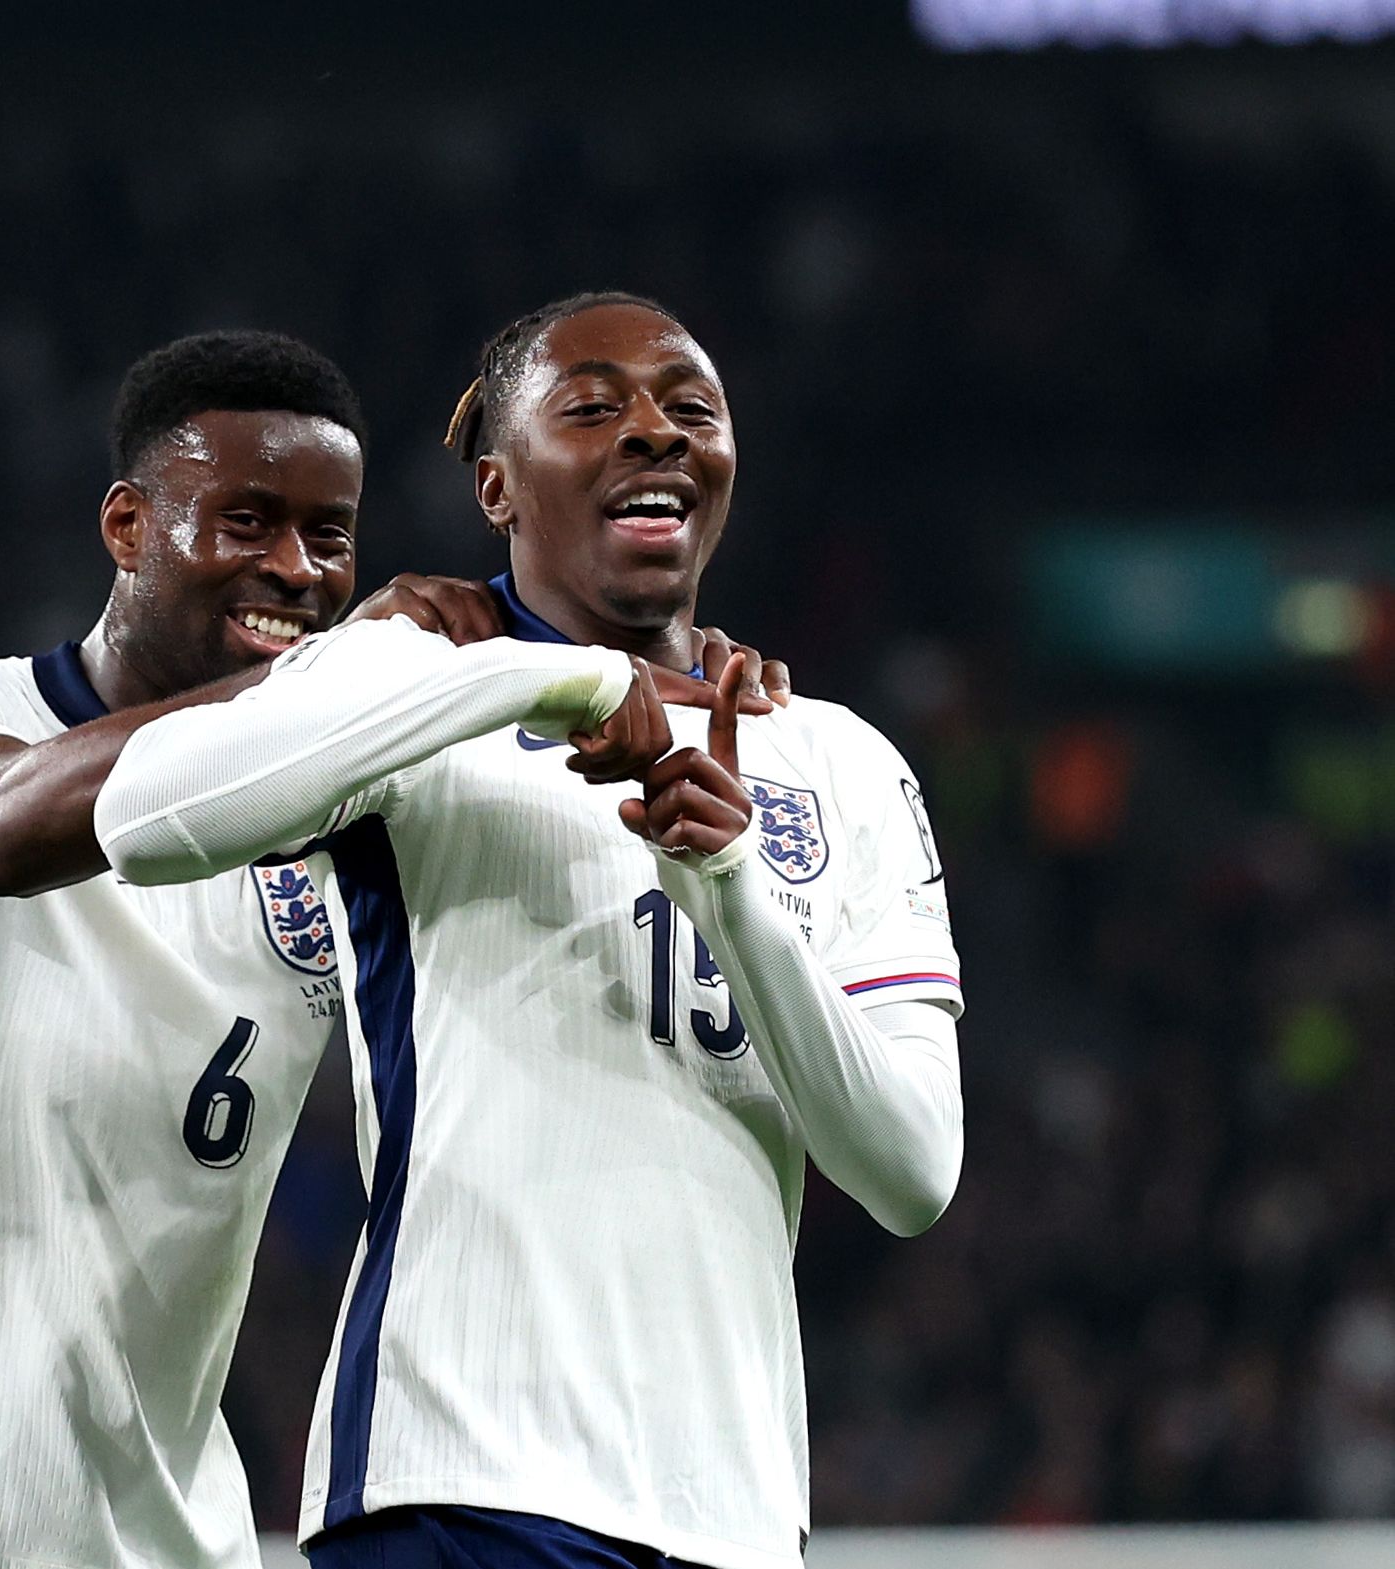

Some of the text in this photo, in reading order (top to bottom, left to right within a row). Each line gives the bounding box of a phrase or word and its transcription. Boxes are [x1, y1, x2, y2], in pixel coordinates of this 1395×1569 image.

[300, 976, 340, 998] LATV
[633, 888, 751, 1060] 15
[183, 1016, 260, 1169] 6
